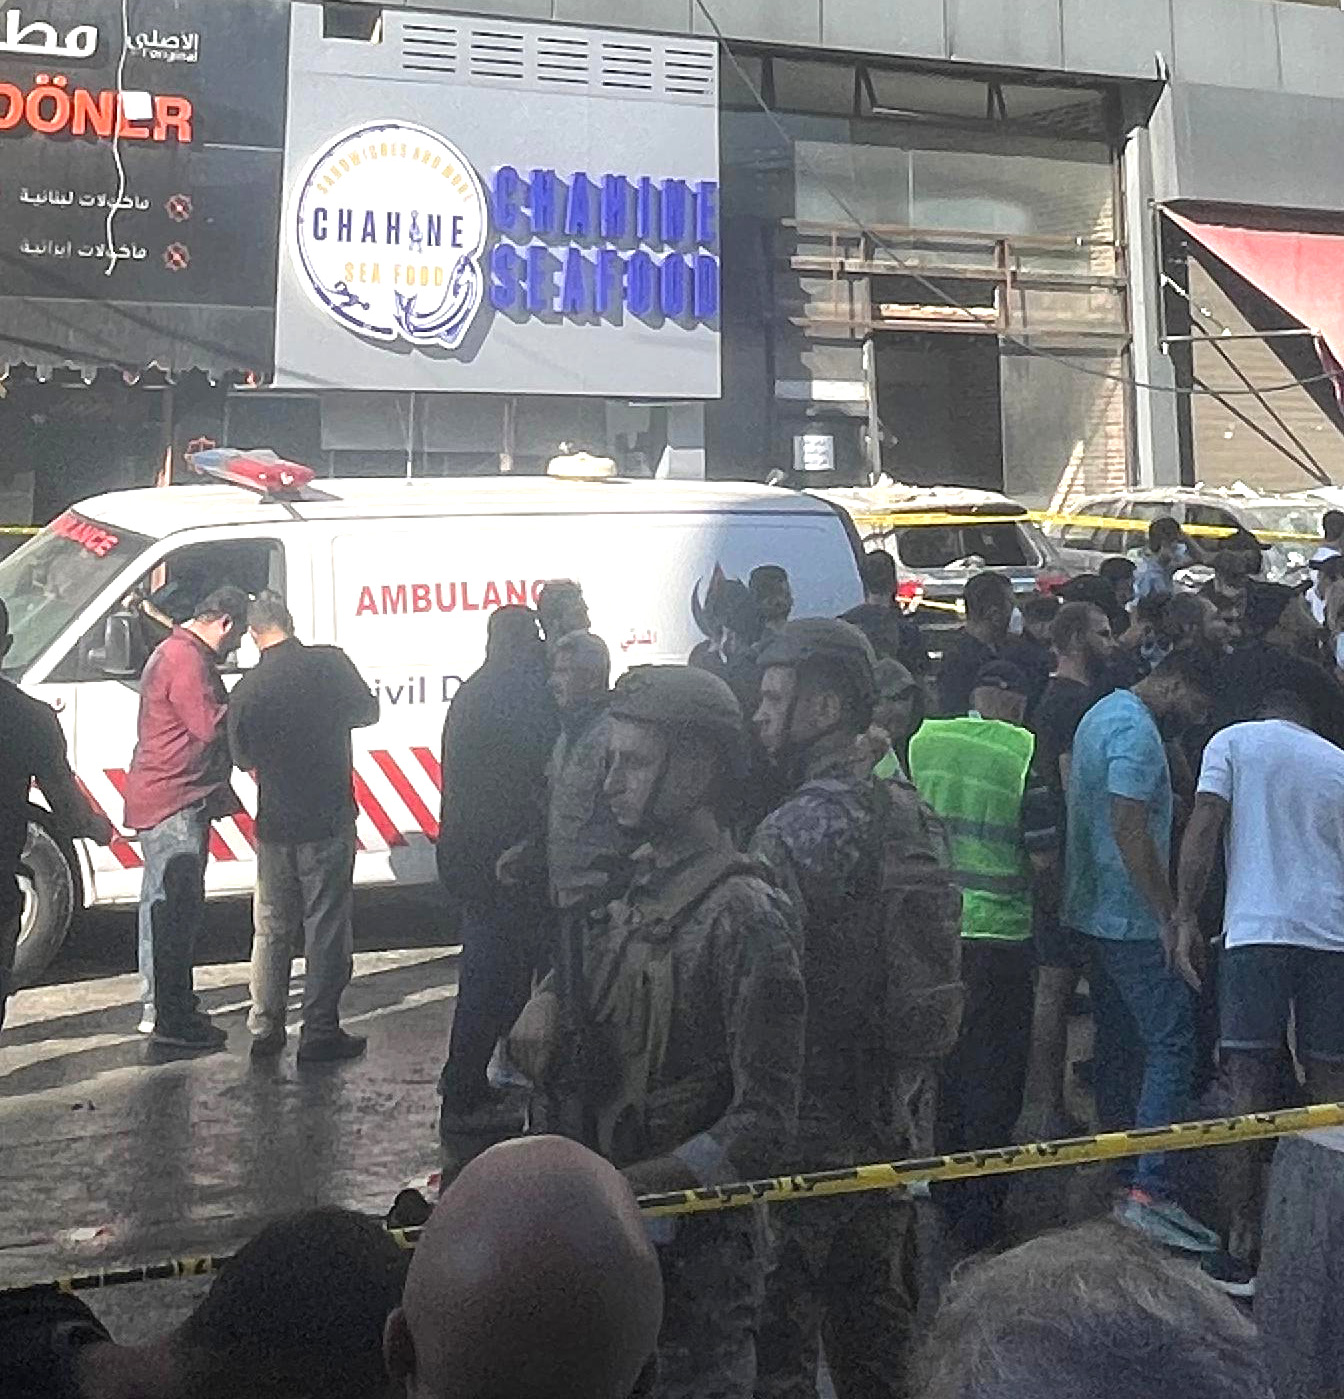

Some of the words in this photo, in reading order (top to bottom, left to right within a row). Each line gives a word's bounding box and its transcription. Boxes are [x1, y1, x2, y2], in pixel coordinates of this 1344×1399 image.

[492, 165, 718, 243] CHAHINE
[344, 261, 381, 284] SEA
[393, 264, 444, 287] FOOD
[490, 243, 719, 318] SEAFOOD
[355, 579, 548, 616] AMBULANC
[372, 675, 426, 705] ivil
